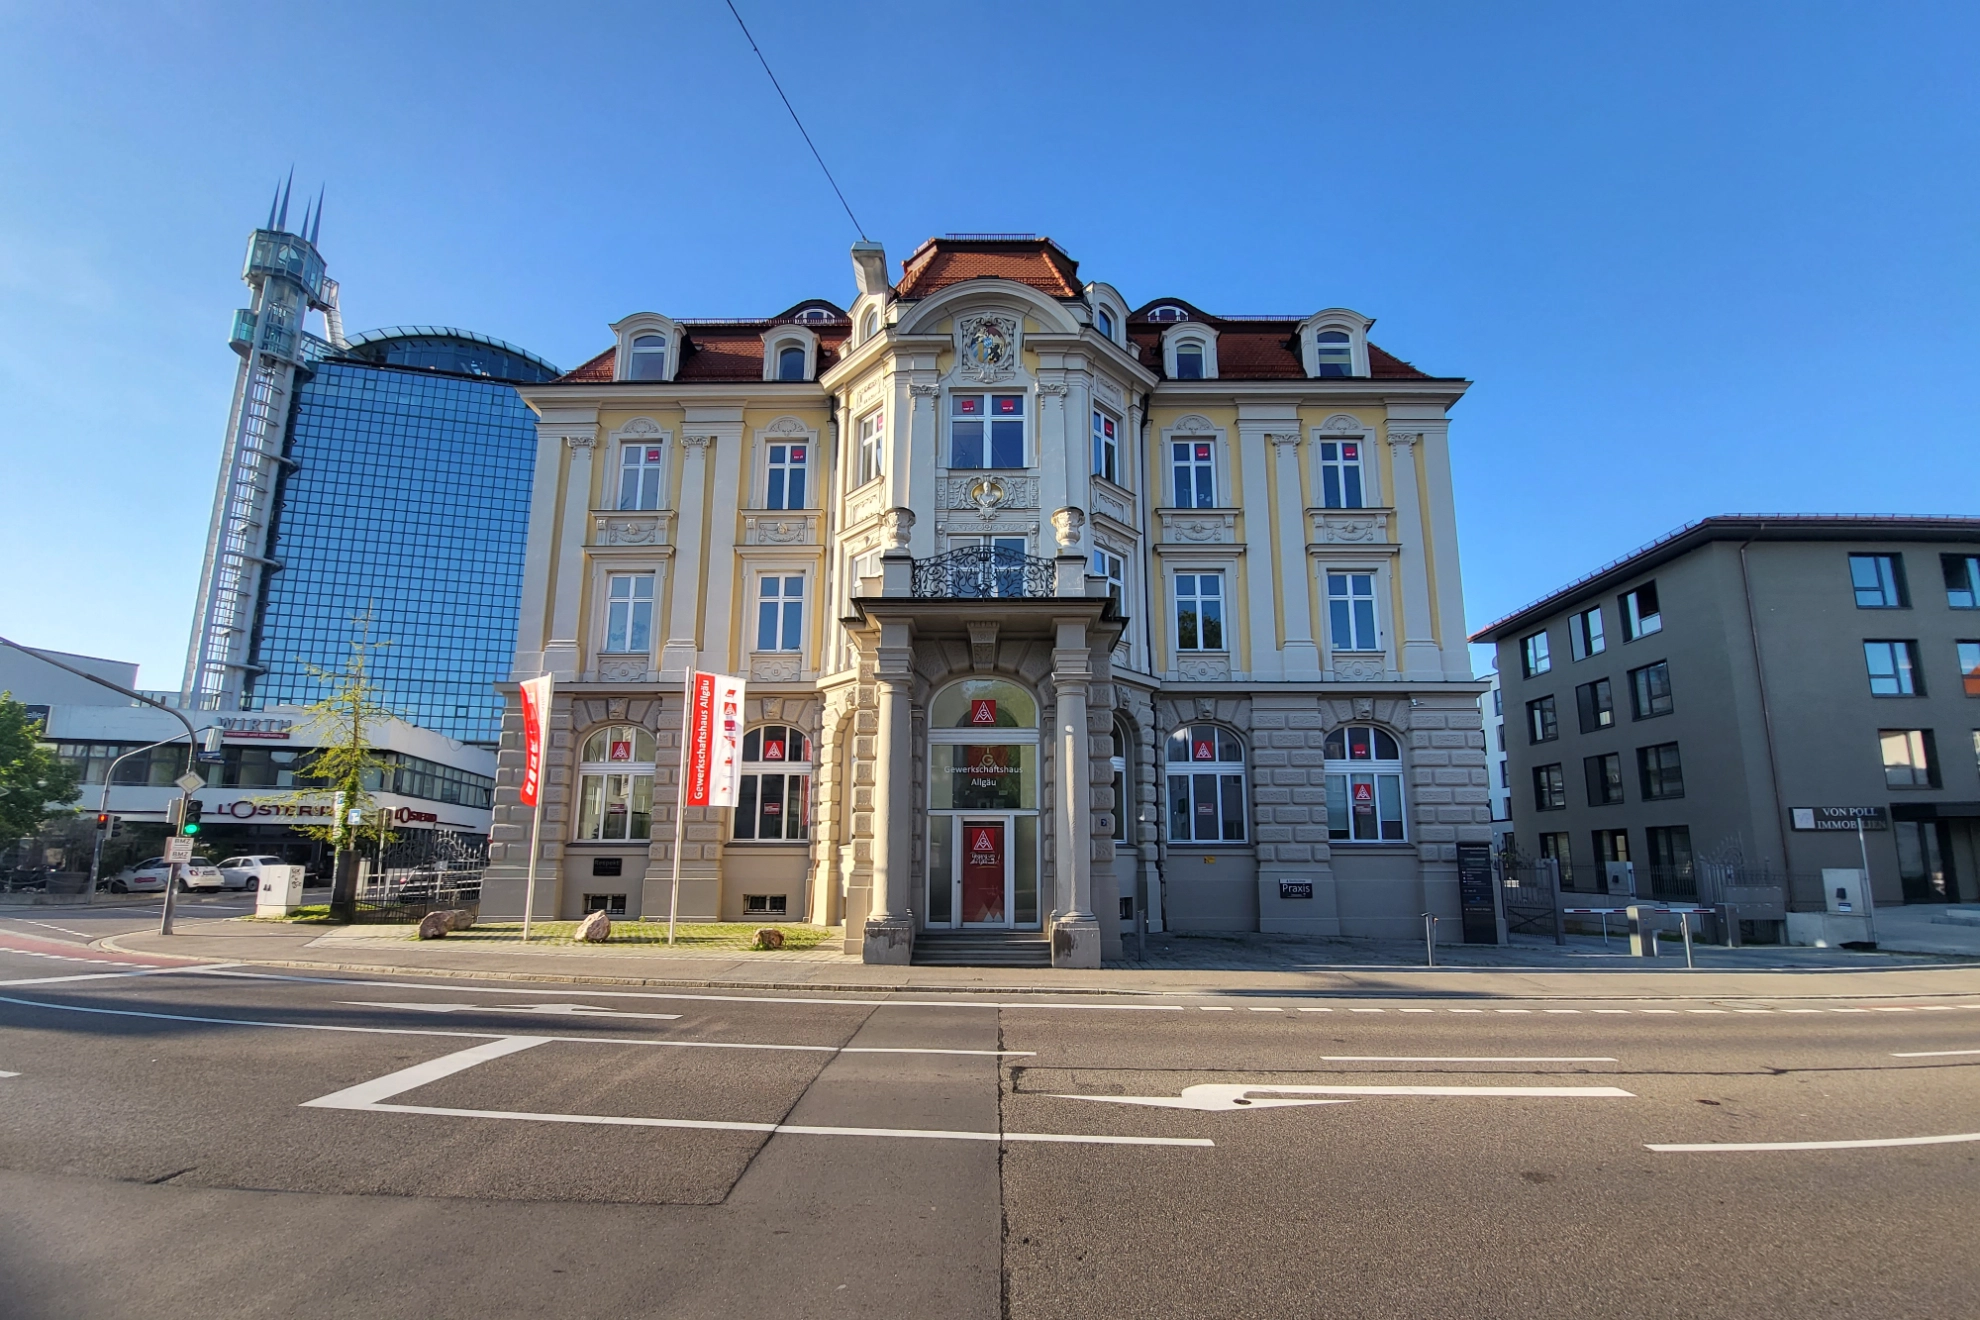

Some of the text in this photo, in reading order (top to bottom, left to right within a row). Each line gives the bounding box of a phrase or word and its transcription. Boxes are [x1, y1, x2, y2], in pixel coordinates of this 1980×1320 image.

[217, 716, 292, 732] WIRTH
[694, 679, 711, 799] Gewerkschaftshaus Allgäu
[943, 765, 1023, 774] Gewerkschaftshaus
[970, 778, 997, 788] Allgäu
[1822, 807, 1878, 817] VON POLL
[1817, 820, 1886, 830] IMMOBLIEN
[1282, 883, 1311, 893] Praxis
